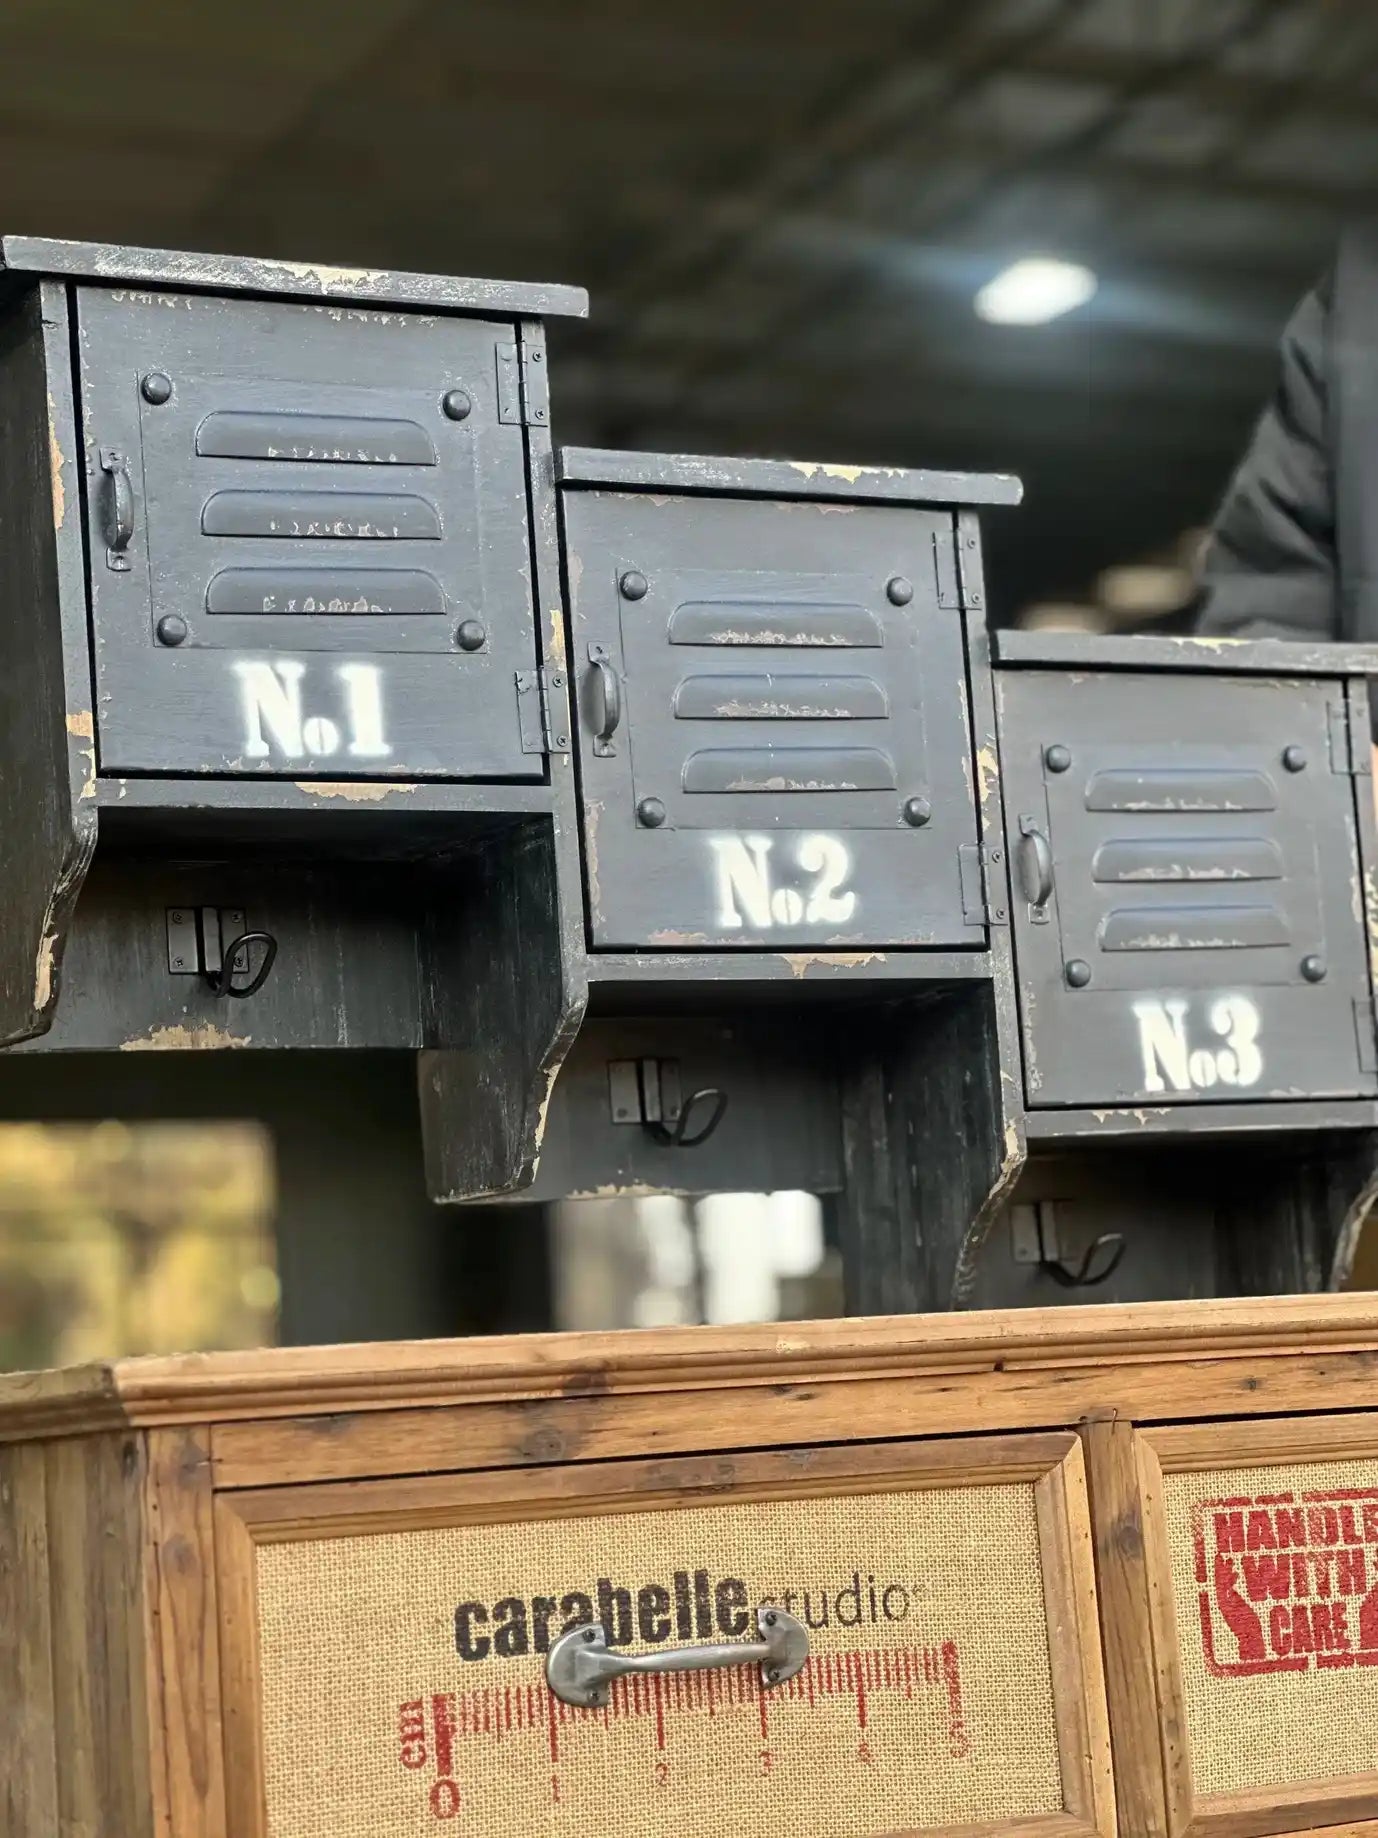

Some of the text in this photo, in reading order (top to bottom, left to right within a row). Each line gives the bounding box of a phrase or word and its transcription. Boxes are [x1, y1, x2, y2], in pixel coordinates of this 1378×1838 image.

[1241, 1549, 1367, 1602] WITH
[454, 1569, 750, 1661] carabelle
[1269, 1602, 1351, 1656] CARE
[655, 1763, 668, 1788] 2
